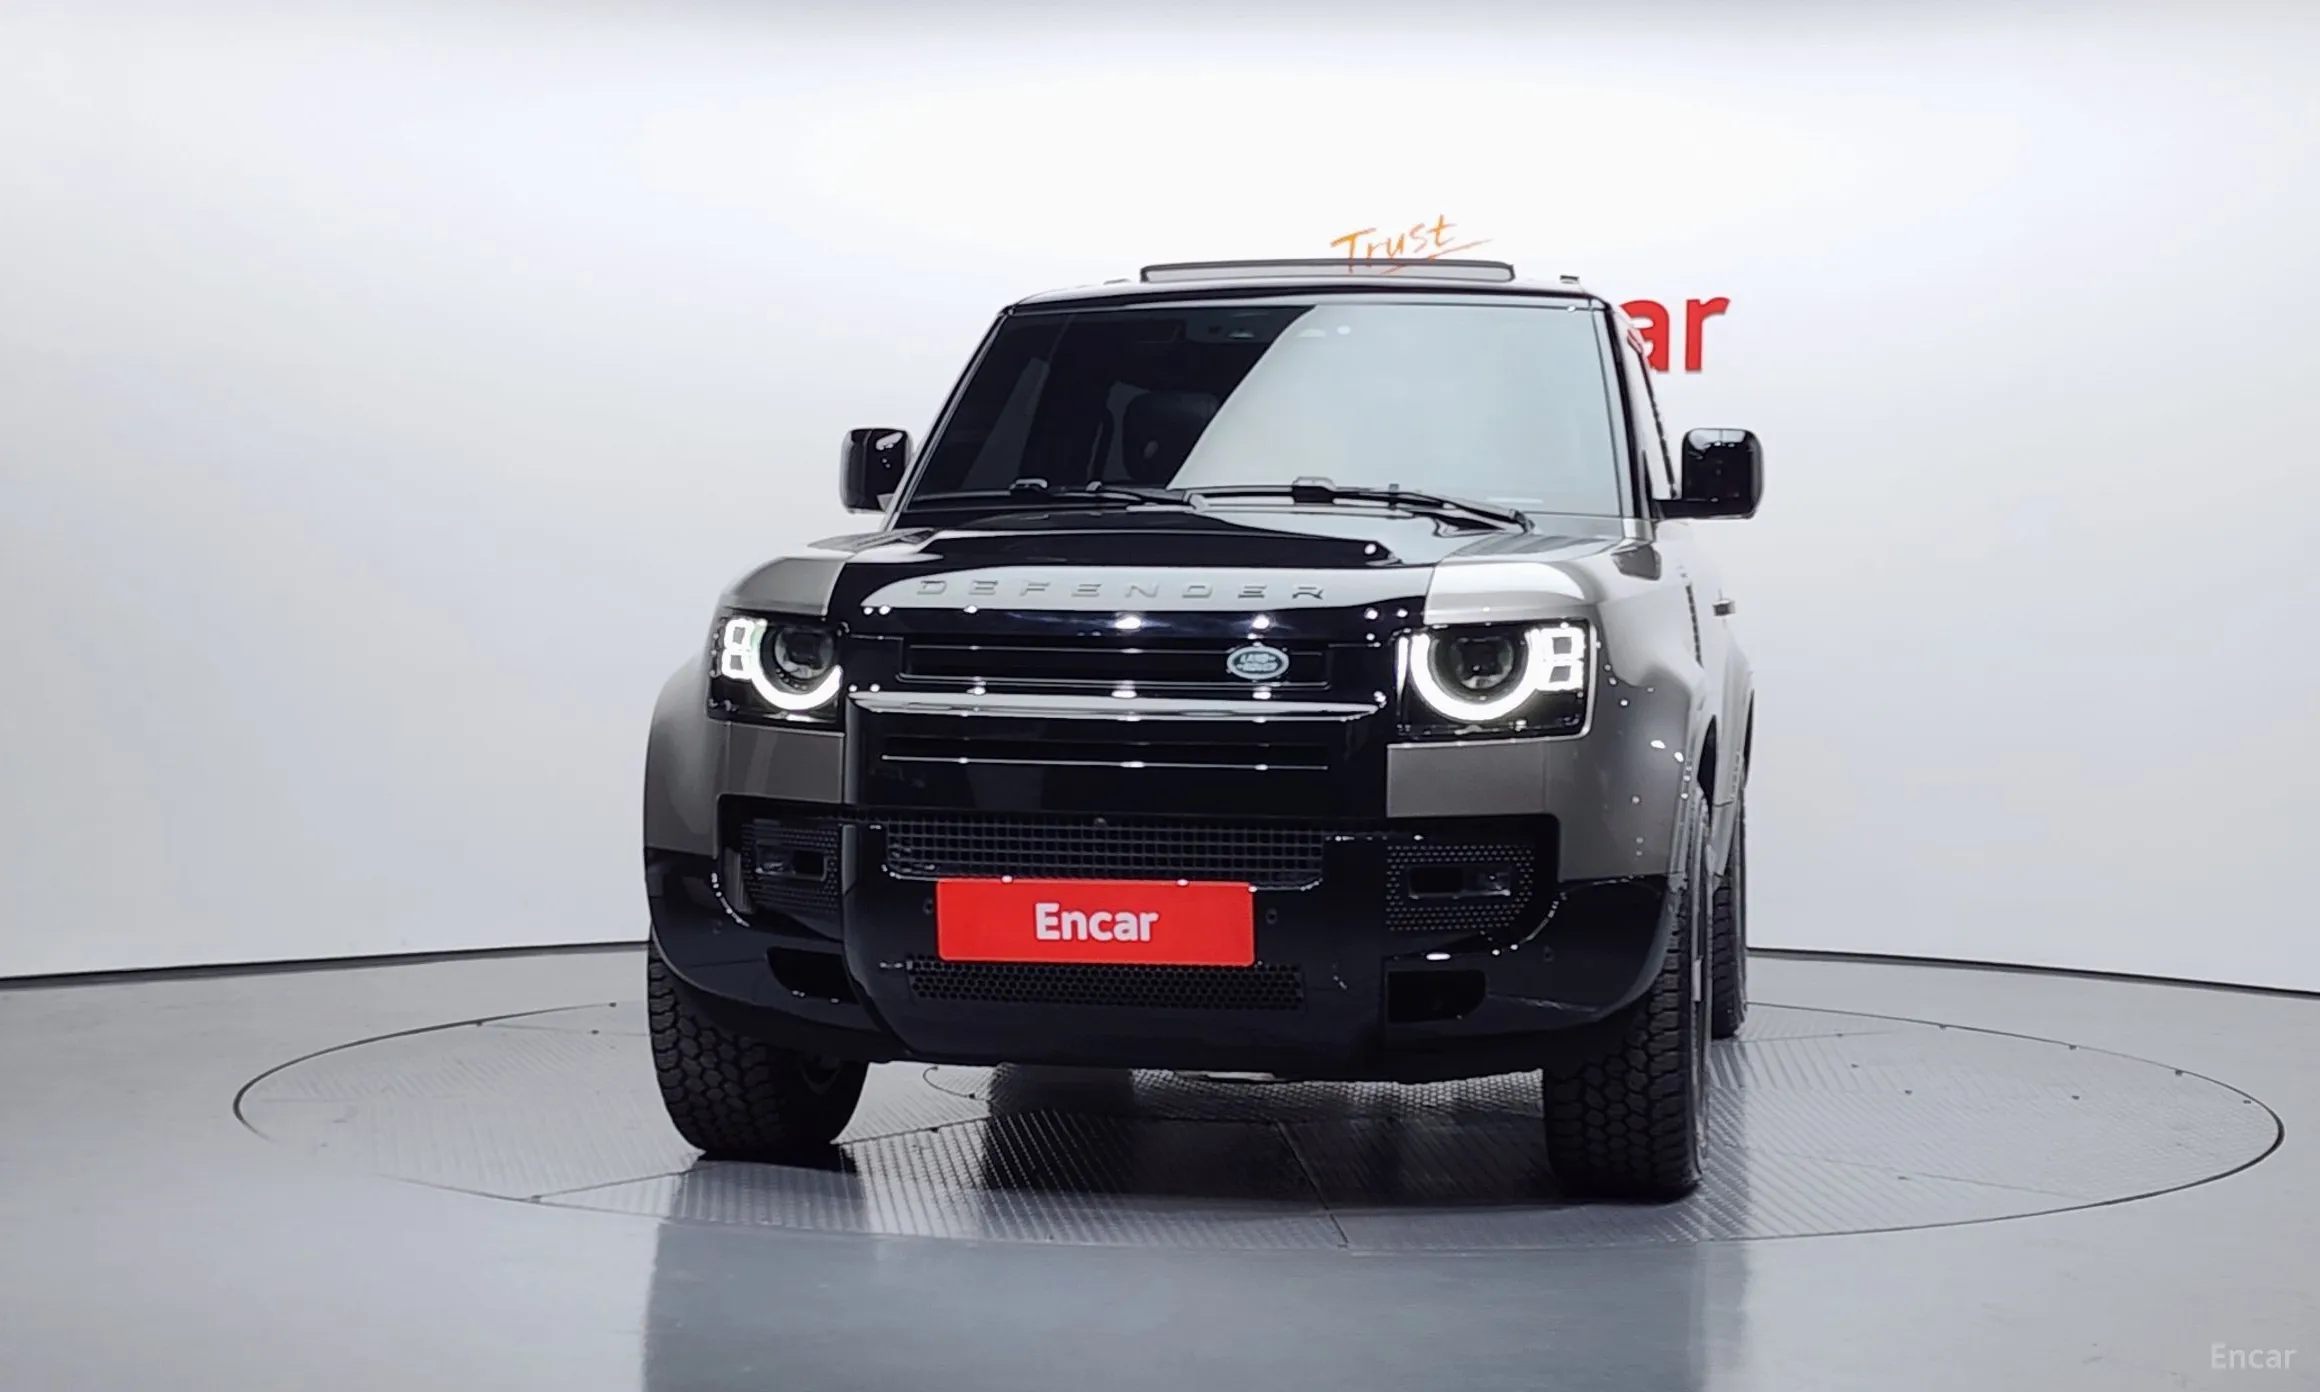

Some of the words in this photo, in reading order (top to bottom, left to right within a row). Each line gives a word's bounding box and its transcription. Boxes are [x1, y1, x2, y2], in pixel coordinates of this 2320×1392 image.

[1330, 214, 1460, 274] Trust
[916, 579, 1325, 600] DEFENDER
[1034, 902, 1159, 942] Encar
